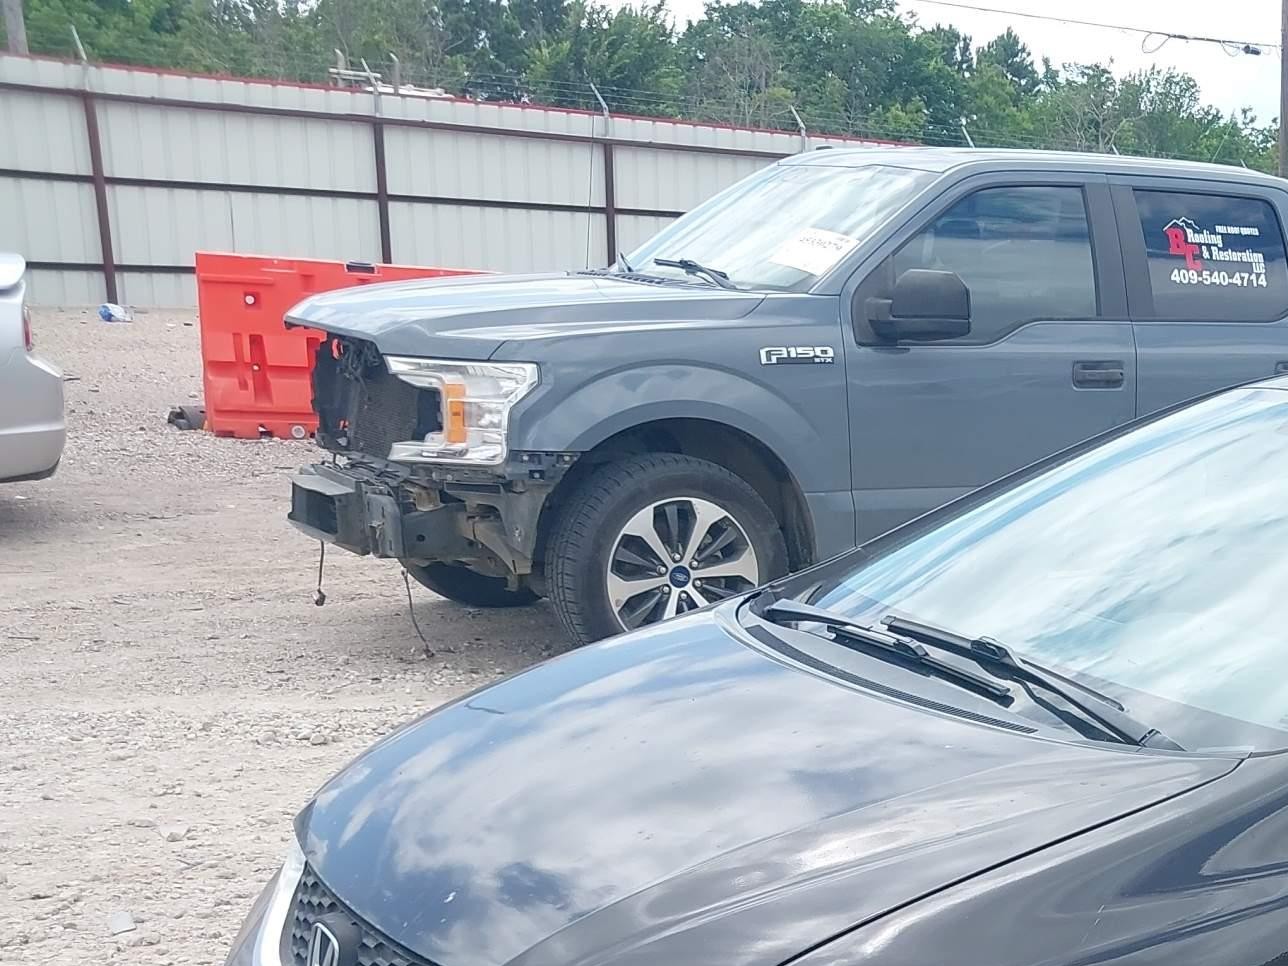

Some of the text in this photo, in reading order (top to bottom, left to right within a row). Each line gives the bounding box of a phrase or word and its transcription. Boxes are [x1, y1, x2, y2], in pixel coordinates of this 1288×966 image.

[1186, 228, 1223, 248] Roofing
[1201, 245, 1265, 263] & Restoration
[1252, 262, 1266, 274] LLC
[1170, 268, 1267, 288] 409-540-4714
[760, 346, 834, 365] F150
